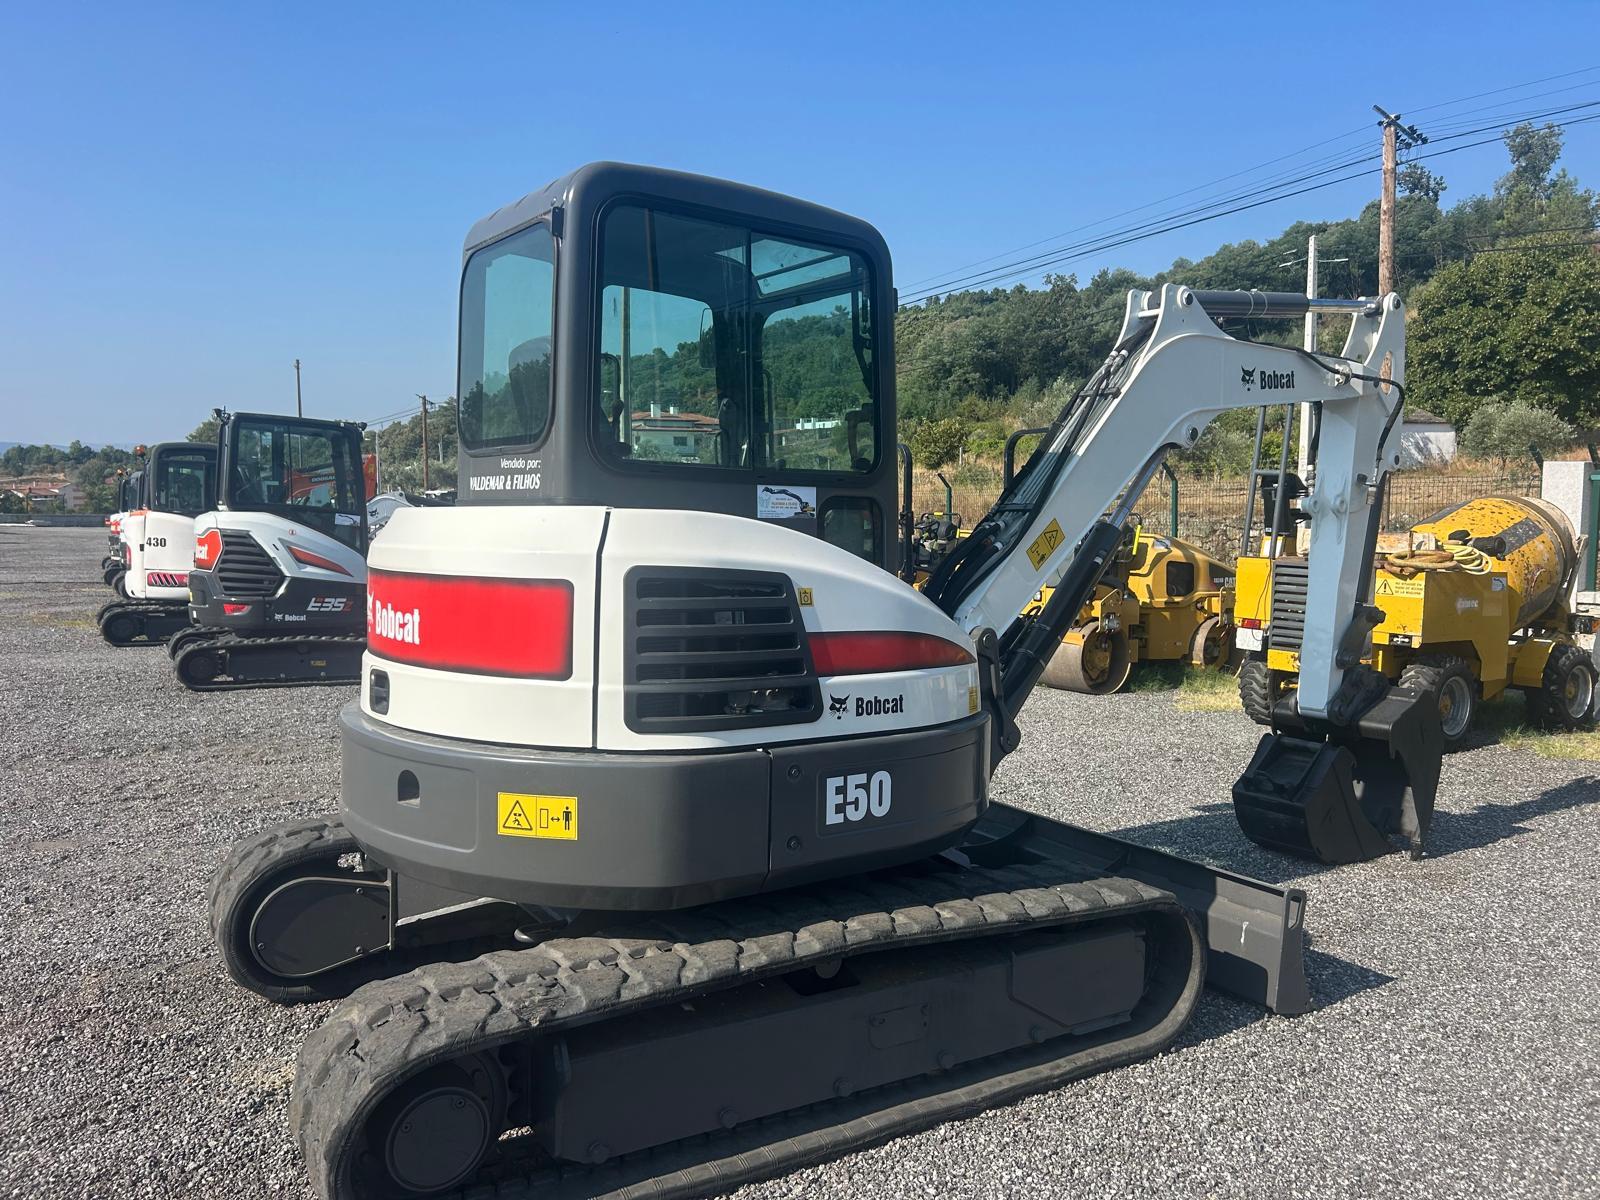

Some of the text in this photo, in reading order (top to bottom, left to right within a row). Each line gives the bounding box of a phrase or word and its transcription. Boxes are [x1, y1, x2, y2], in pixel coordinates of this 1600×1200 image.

[1260, 370, 1295, 390] Bobcat
[501, 458, 542, 471] Vendido por:
[470, 474, 541, 491] VALDEMAR & FILHOS
[146, 537, 167, 548] 430
[375, 599, 420, 646] Bobcat
[855, 694, 904, 717] Bobcat
[826, 770, 892, 825] E50
